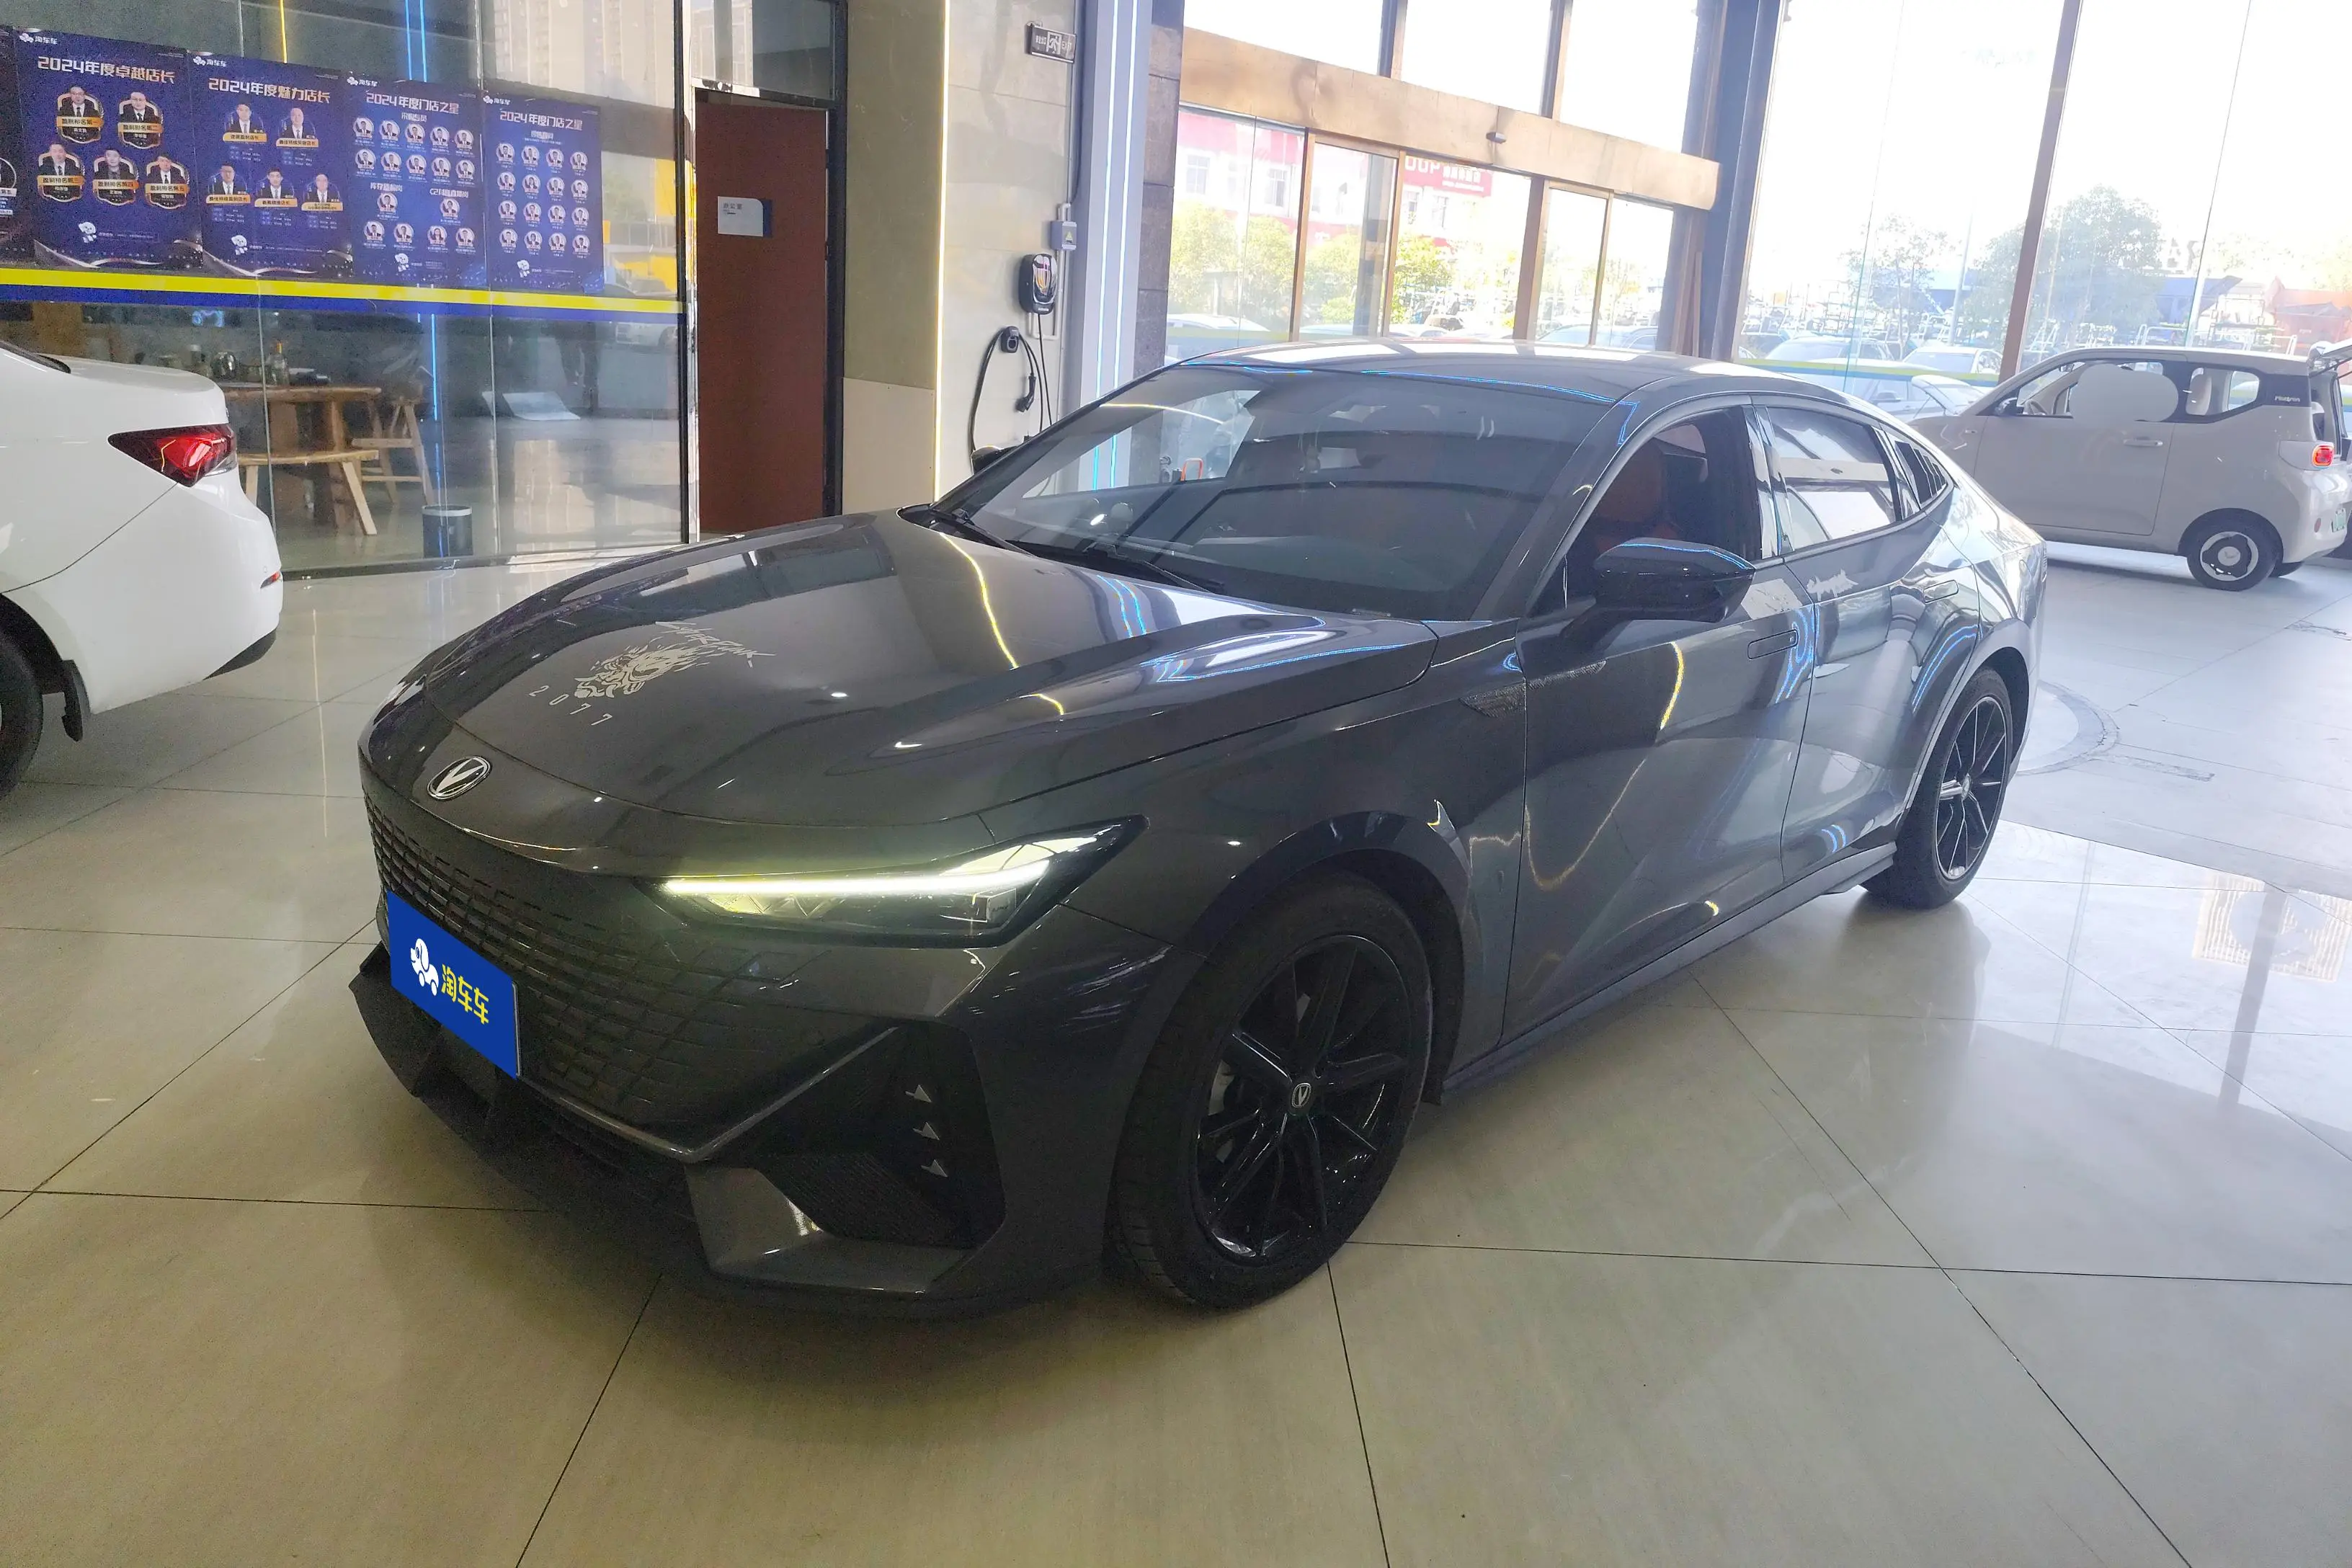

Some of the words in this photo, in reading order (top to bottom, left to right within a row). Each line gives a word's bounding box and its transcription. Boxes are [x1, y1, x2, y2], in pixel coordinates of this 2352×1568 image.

[35, 35, 58, 45] 淘车车
[37, 55, 175, 84] 2024年度卓越店长
[206, 58, 227, 68] 淘车车
[208, 77, 331, 104] 2024年度魅力店长
[528, 685, 613, 726] 2077
